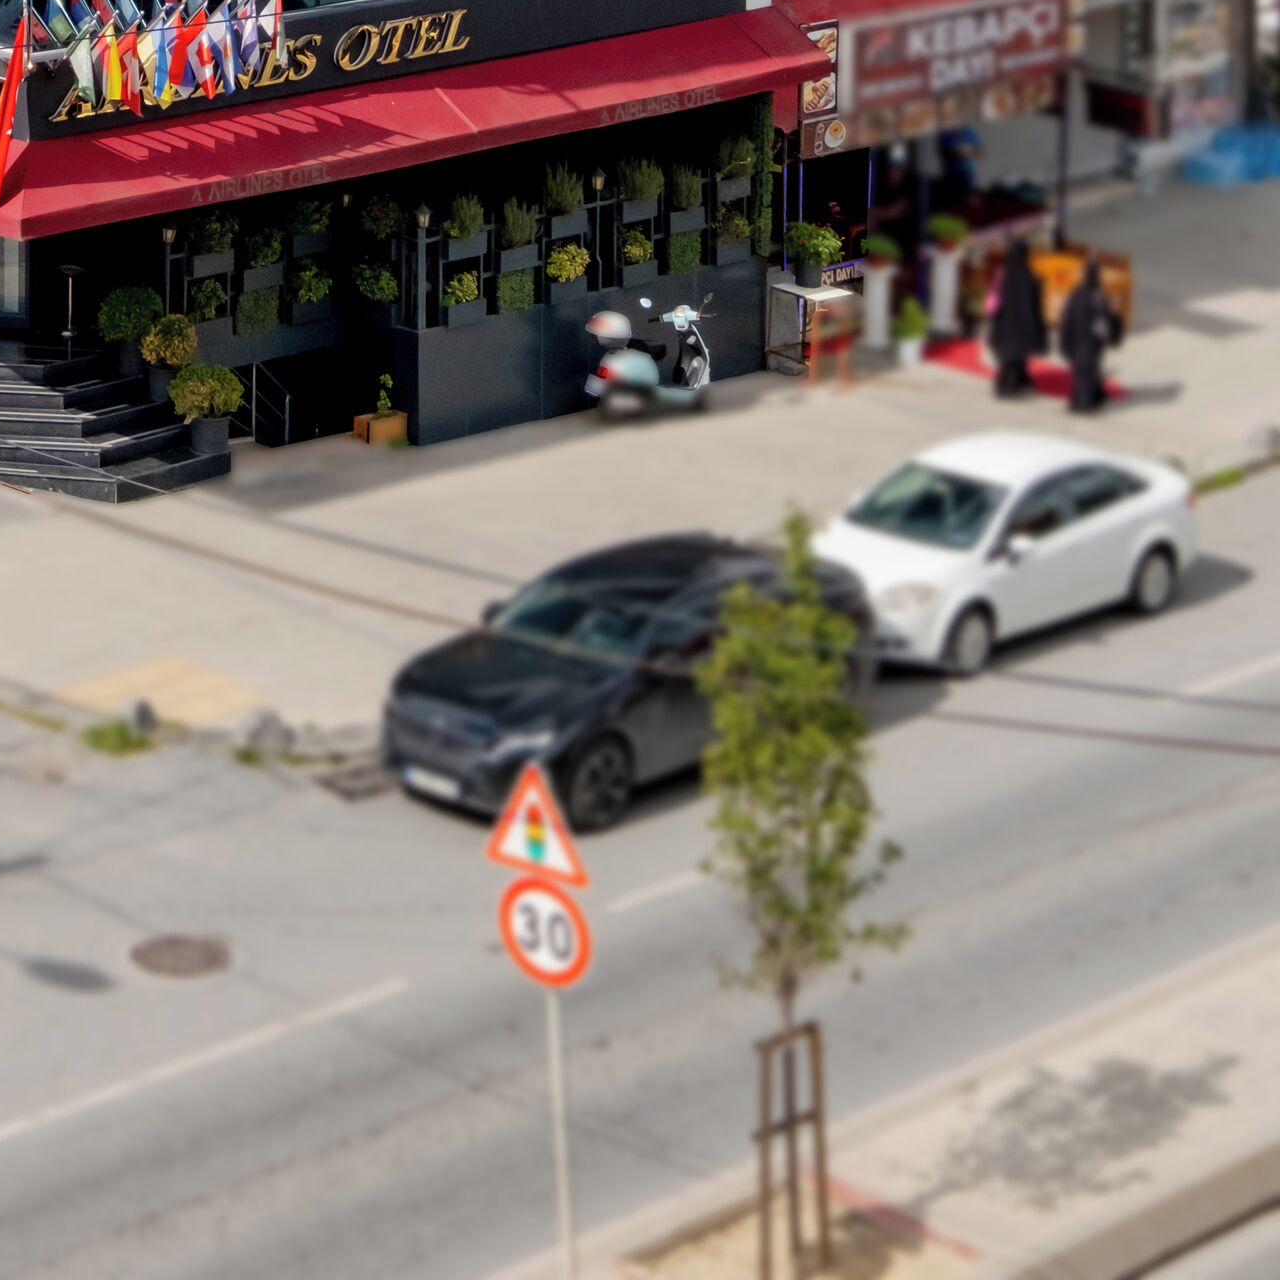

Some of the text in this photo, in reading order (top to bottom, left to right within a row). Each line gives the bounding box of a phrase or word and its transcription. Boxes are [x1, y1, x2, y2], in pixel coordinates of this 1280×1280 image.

[333, 8, 470, 72] OTEL
[907, 0, 1060, 57] KEBAPÇI
[614, 94, 680, 122] AIRLINES
[684, 86, 721, 106] OTEL
[208, 172, 283, 201] AIRLINES
[289, 163, 330, 184] OTEL
[520, 903, 571, 961] 30
